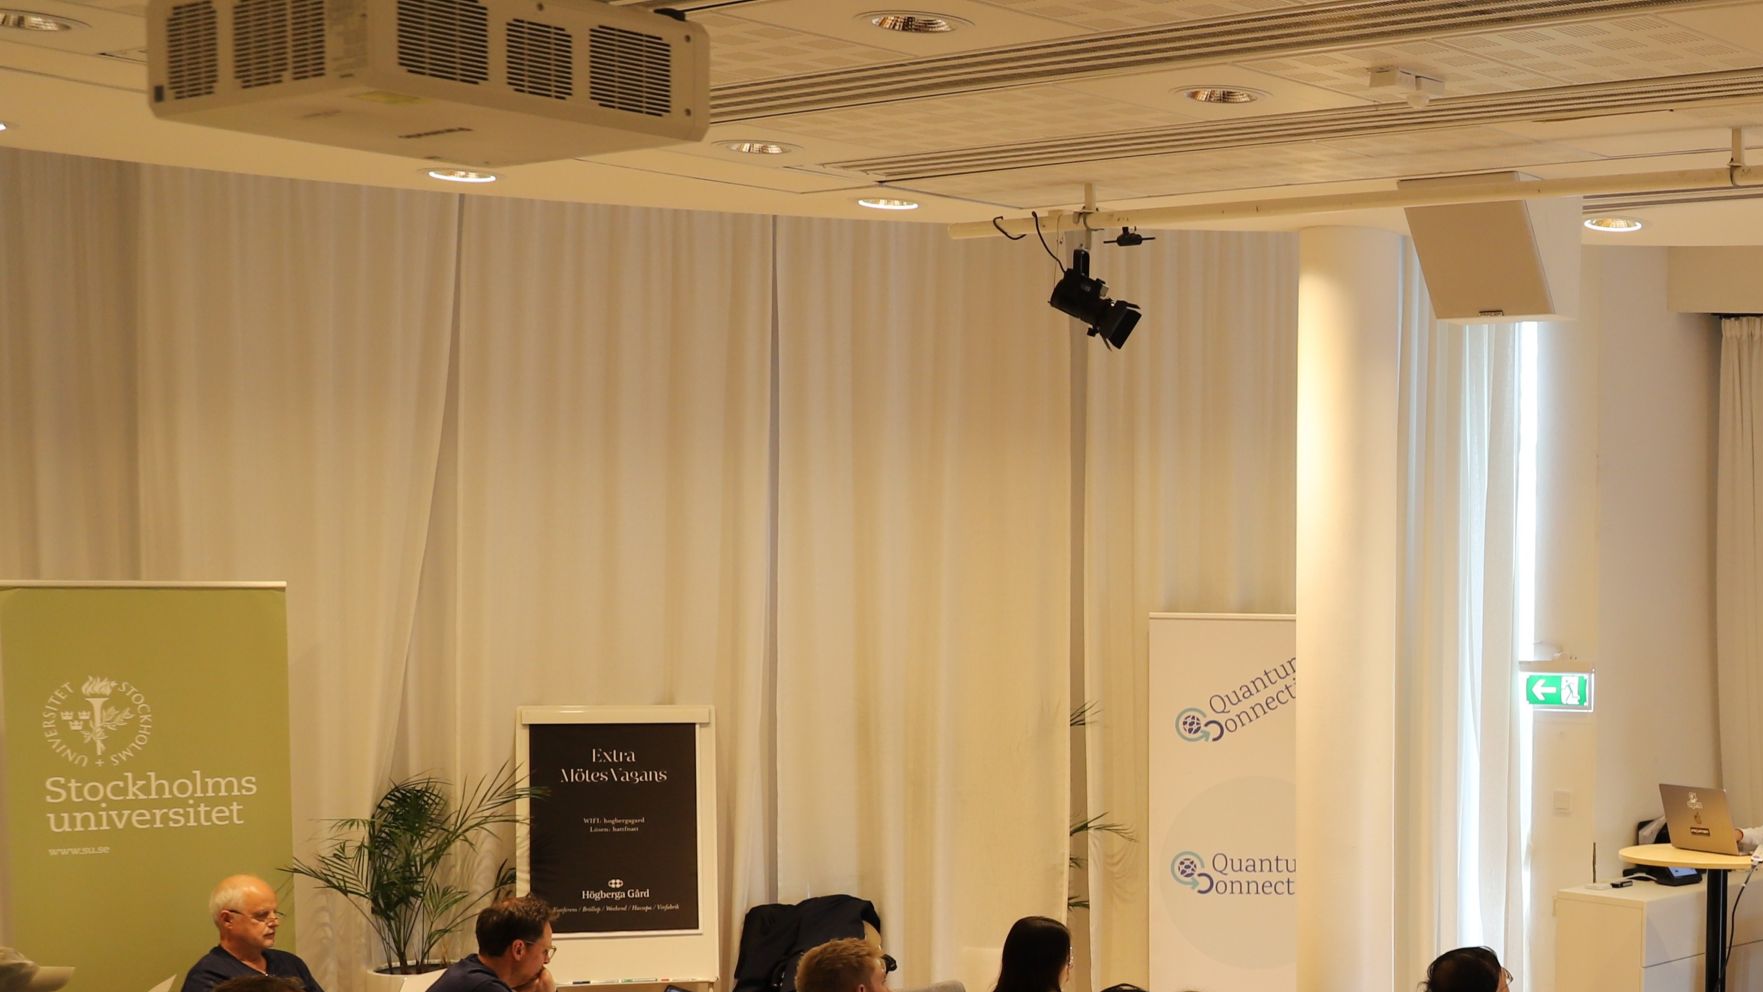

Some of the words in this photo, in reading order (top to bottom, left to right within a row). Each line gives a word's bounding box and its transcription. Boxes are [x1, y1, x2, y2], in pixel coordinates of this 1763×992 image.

[592, 748, 636, 763] Extra
[560, 767, 609, 783] Mötes
[610, 767, 668, 784] Vagans
[45, 770, 257, 803] Stockholms
[46, 799, 244, 833] universitet
[48, 846, 111, 857] www.su.se
[582, 889, 626, 901] Högberga
[627, 888, 650, 899] Gård
